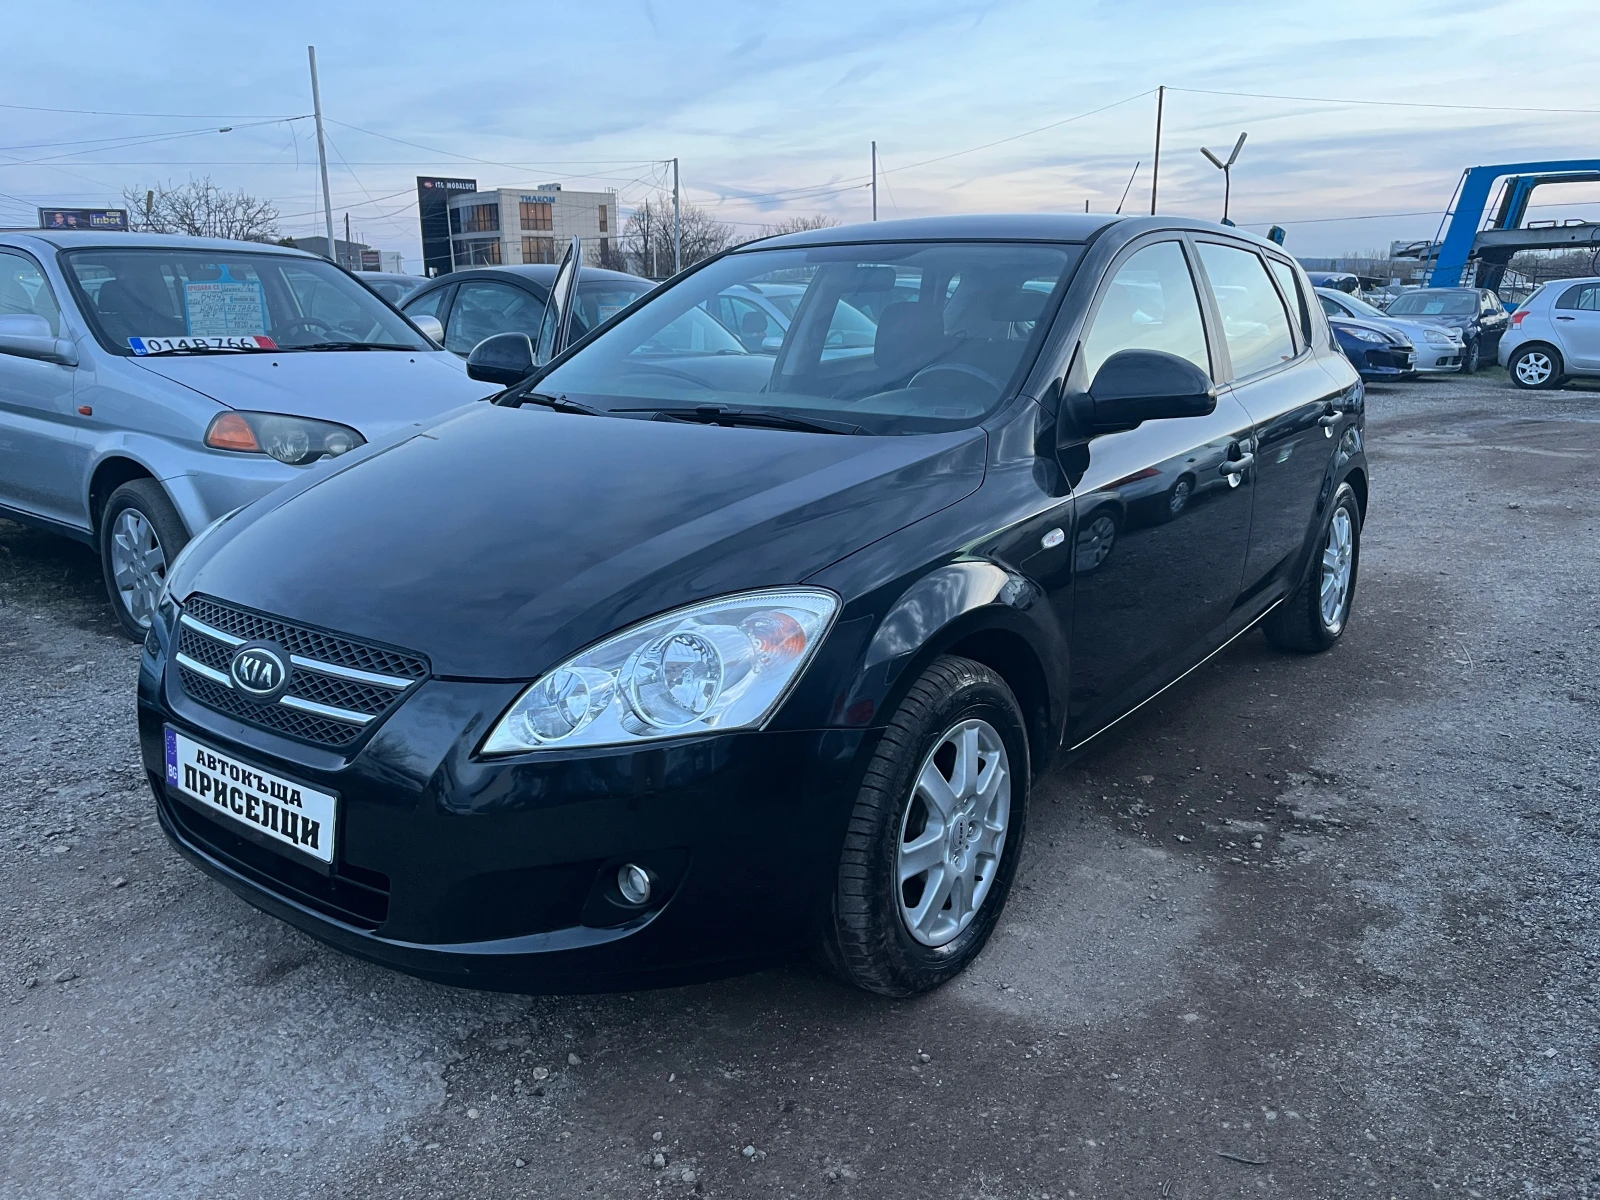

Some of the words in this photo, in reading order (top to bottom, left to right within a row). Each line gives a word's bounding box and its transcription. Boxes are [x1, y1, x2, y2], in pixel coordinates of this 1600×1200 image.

[240, 655, 273, 688] KIA
[168, 763, 178, 780] BG
[196, 749, 303, 808] АВТОКЪЩА
[184, 763, 320, 850] ПРИСЕЛЦИ
